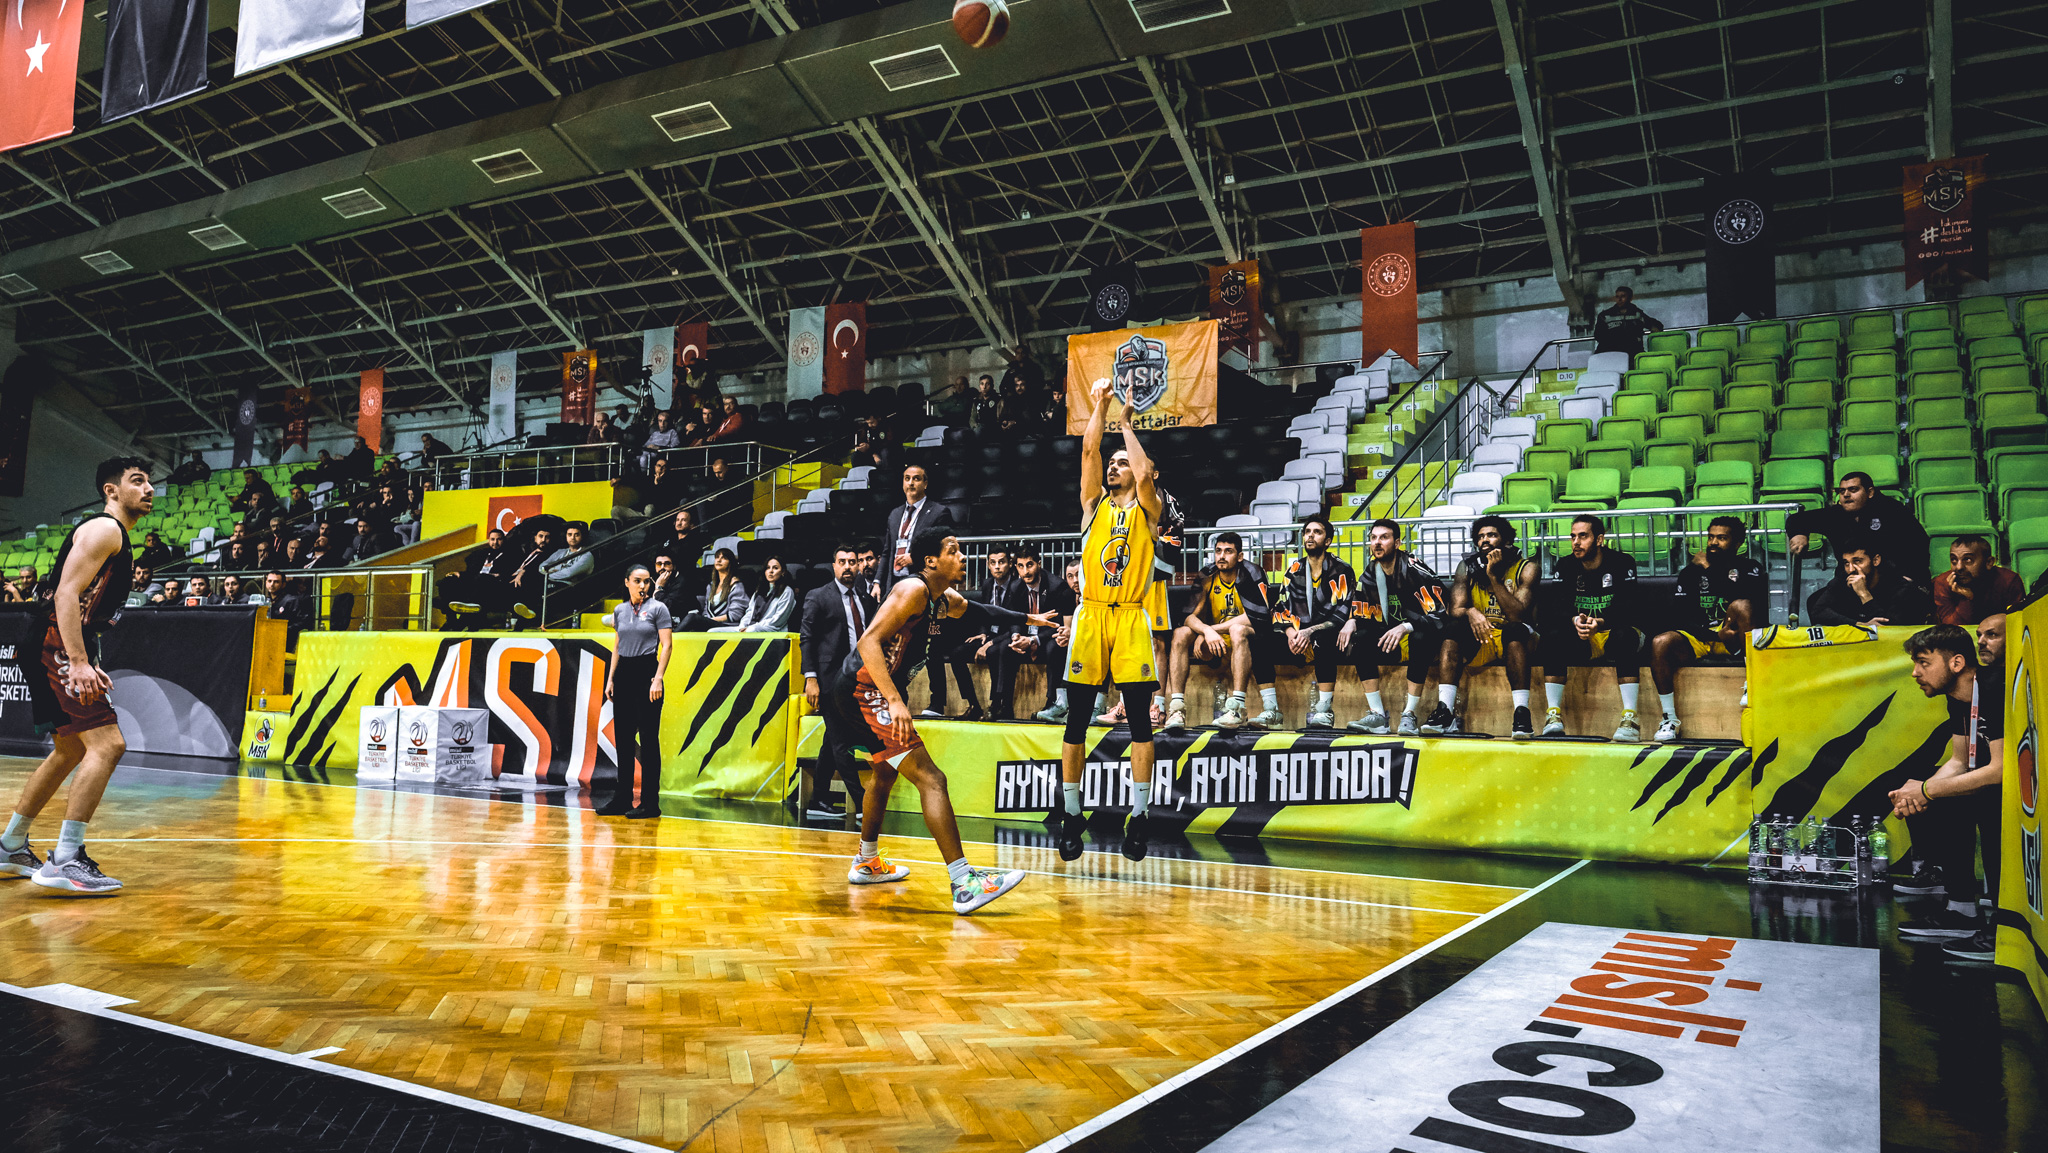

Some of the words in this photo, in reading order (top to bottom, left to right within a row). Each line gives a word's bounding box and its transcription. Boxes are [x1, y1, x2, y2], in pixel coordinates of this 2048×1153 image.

[1923, 187, 1964, 203] MSK
[1221, 285, 1245, 298] MSK
[1118, 367, 1164, 387] MSK
[1368, 446, 1380, 454] C.7
[1484, 607, 1502, 615] MERS
[1807, 627, 1824, 640] 18
[0, 684, 32, 701] SKETB
[248, 741, 270, 758] MSK
[1080, 759, 1185, 812] OTAA,
